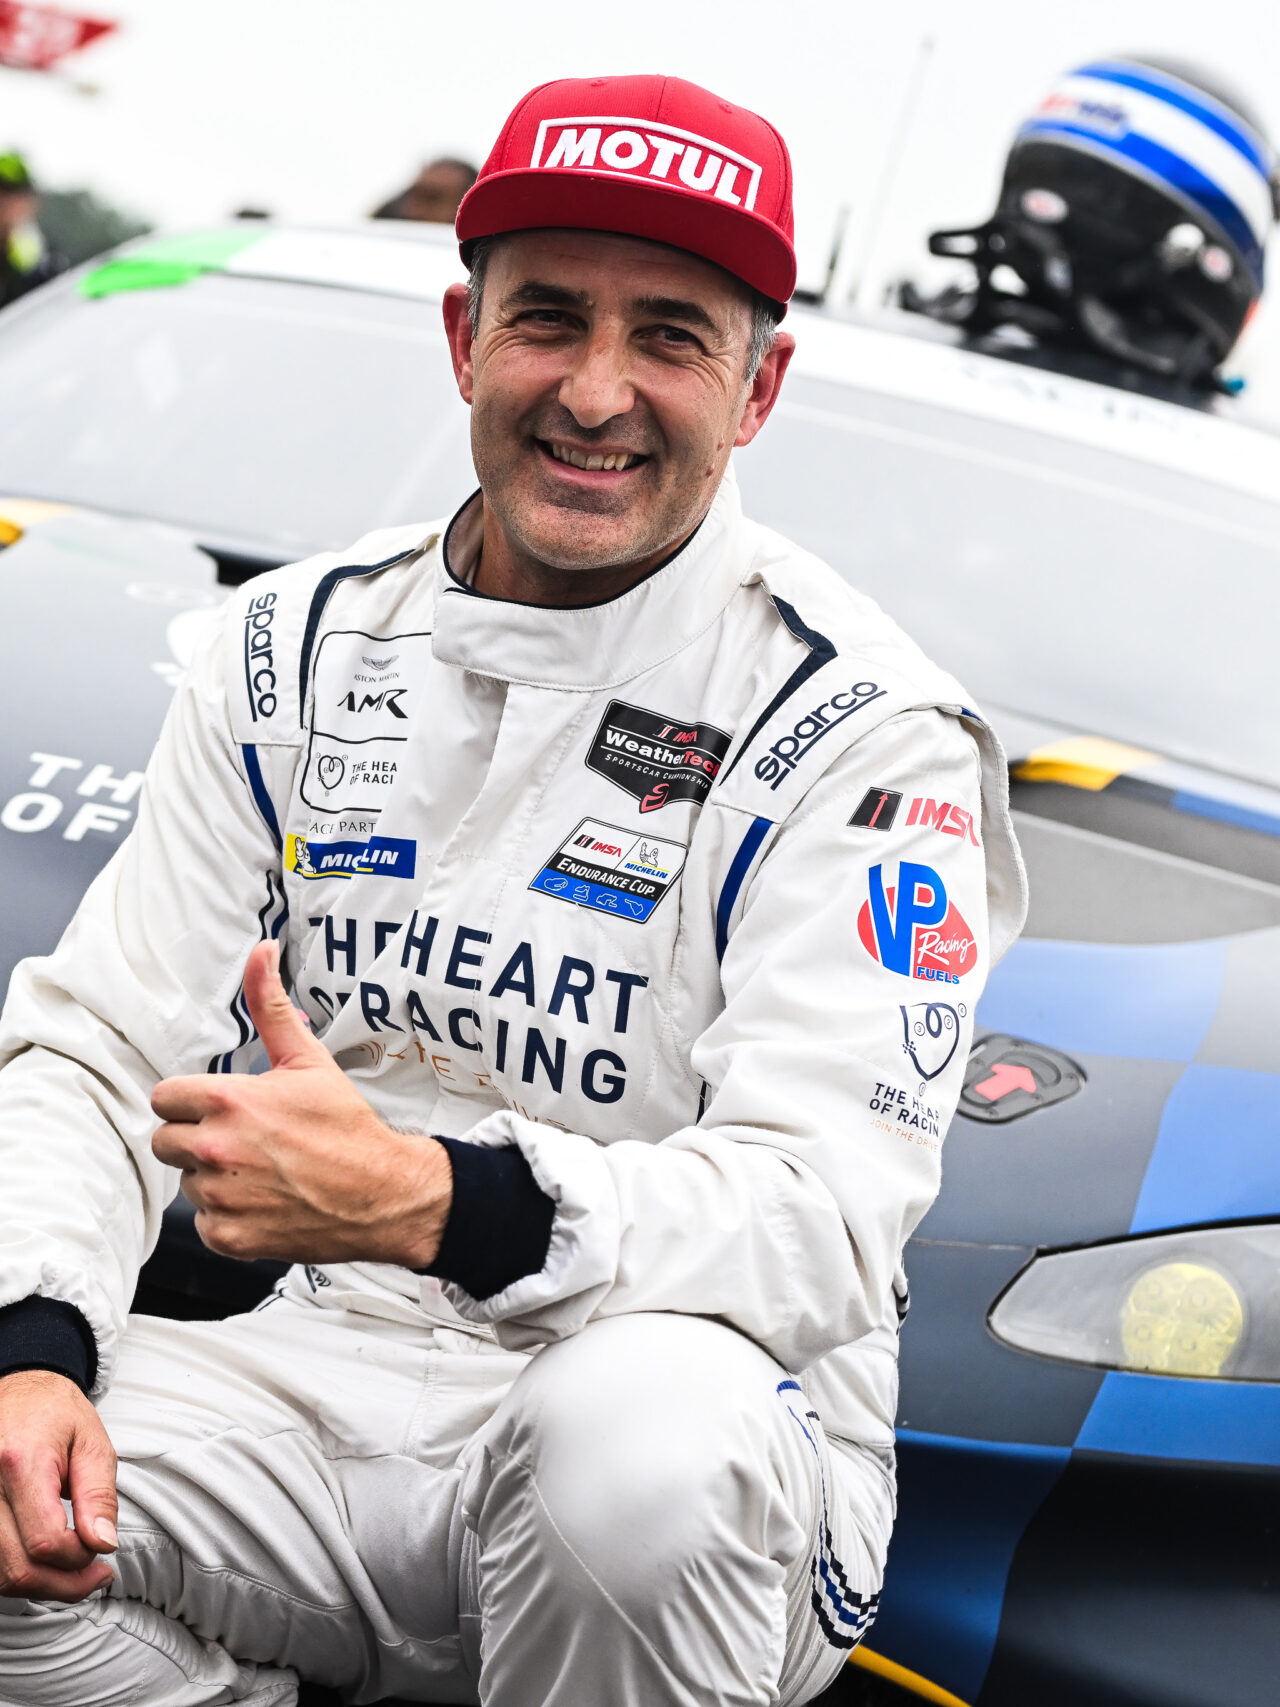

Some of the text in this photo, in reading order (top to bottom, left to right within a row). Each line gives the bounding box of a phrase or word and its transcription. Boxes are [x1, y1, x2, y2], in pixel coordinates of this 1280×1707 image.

[544, 127, 742, 207] MOTUL
[245, 592, 277, 719] sparco
[754, 681, 880, 786] sparco
[1, 792, 132, 842] OF
[320, 849, 399, 869] MICLIN
[590, 841, 622, 857] IMSA
[624, 862, 668, 879] MICHELIN
[869, 861, 947, 977] VP
[918, 931, 976, 966] Racing
[400, 909, 650, 1034] HEART
[916, 966, 960, 985] FUELS
[359, 981, 627, 1104] RACING
[875, 1082, 907, 1105] THE
[869, 1098, 939, 1137] OF RACIN
[895, 1127, 915, 1141] THE
